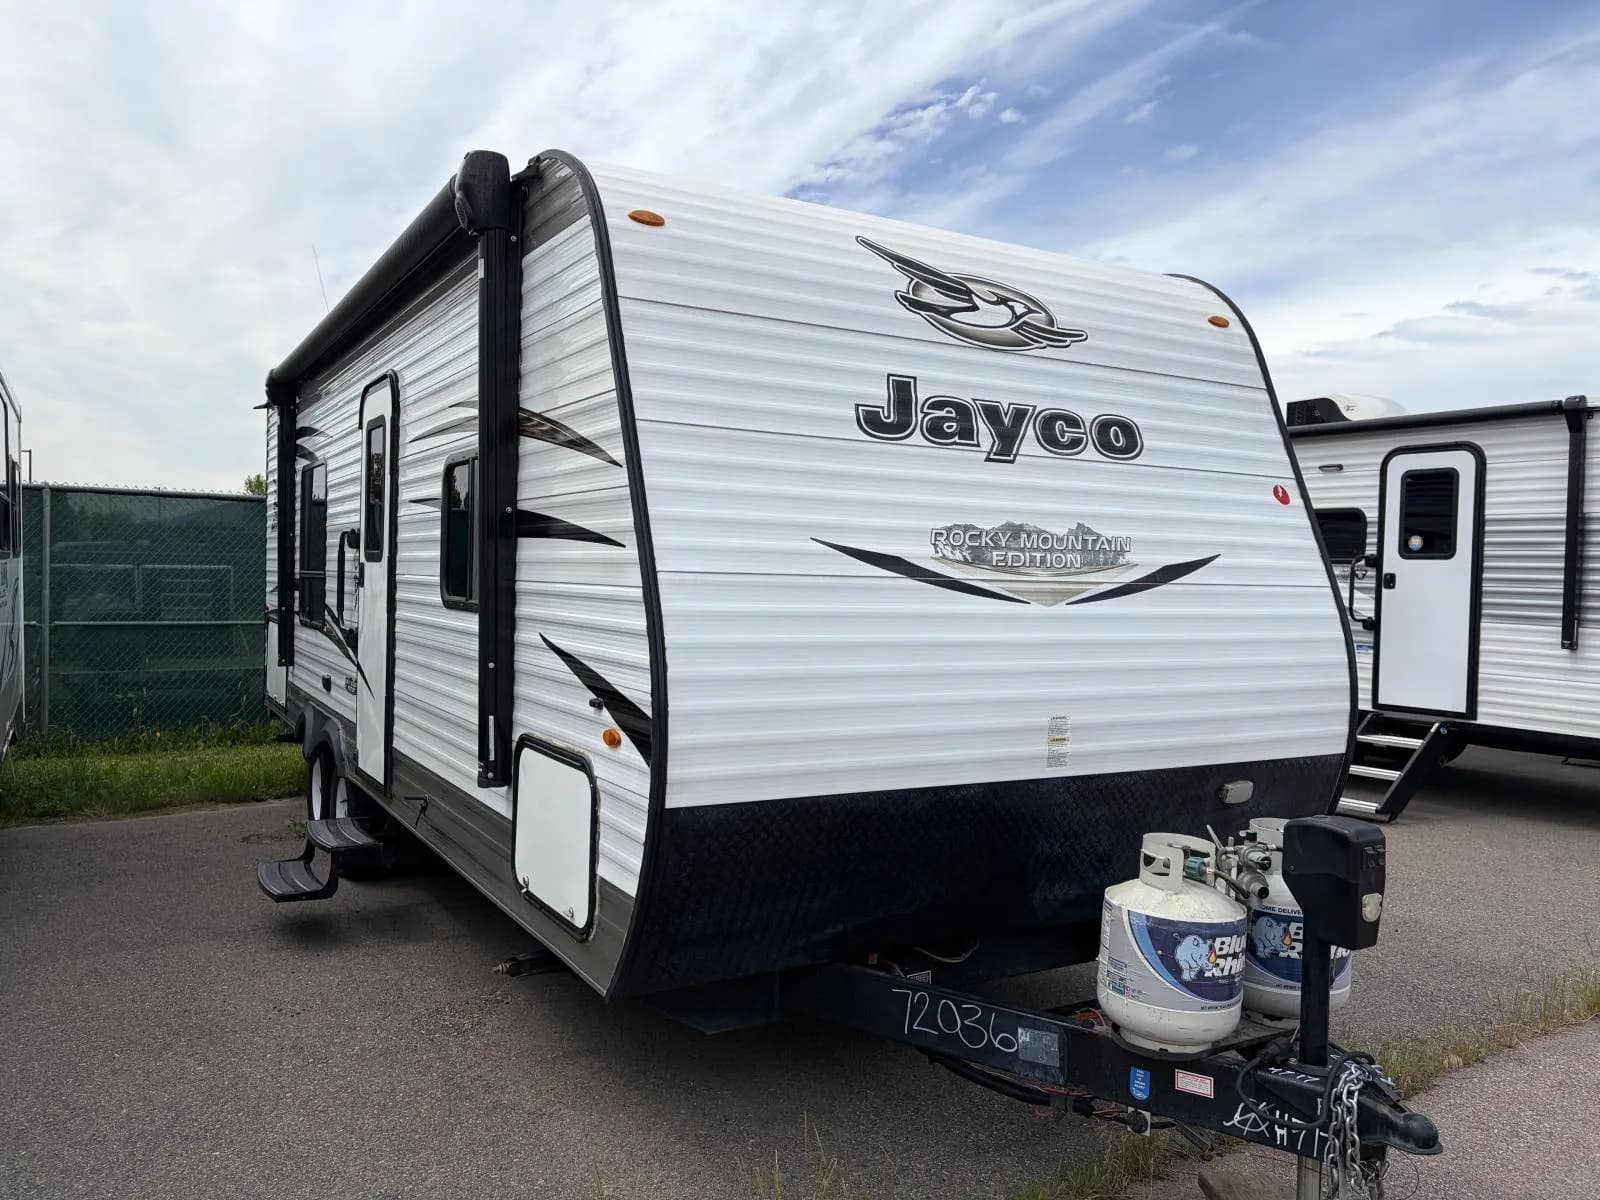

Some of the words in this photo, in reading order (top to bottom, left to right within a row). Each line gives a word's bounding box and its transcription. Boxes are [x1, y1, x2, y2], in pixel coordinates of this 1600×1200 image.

[855, 373, 1144, 463] Jayco
[930, 528, 1012, 548] ROCKY
[1020, 533, 1132, 552] MOUNTAIN
[992, 551, 1082, 569] EDITION
[1278, 907, 1302, 915] DELIVE
[1215, 935, 1246, 955] Blu
[892, 989, 1018, 1053] 72036
